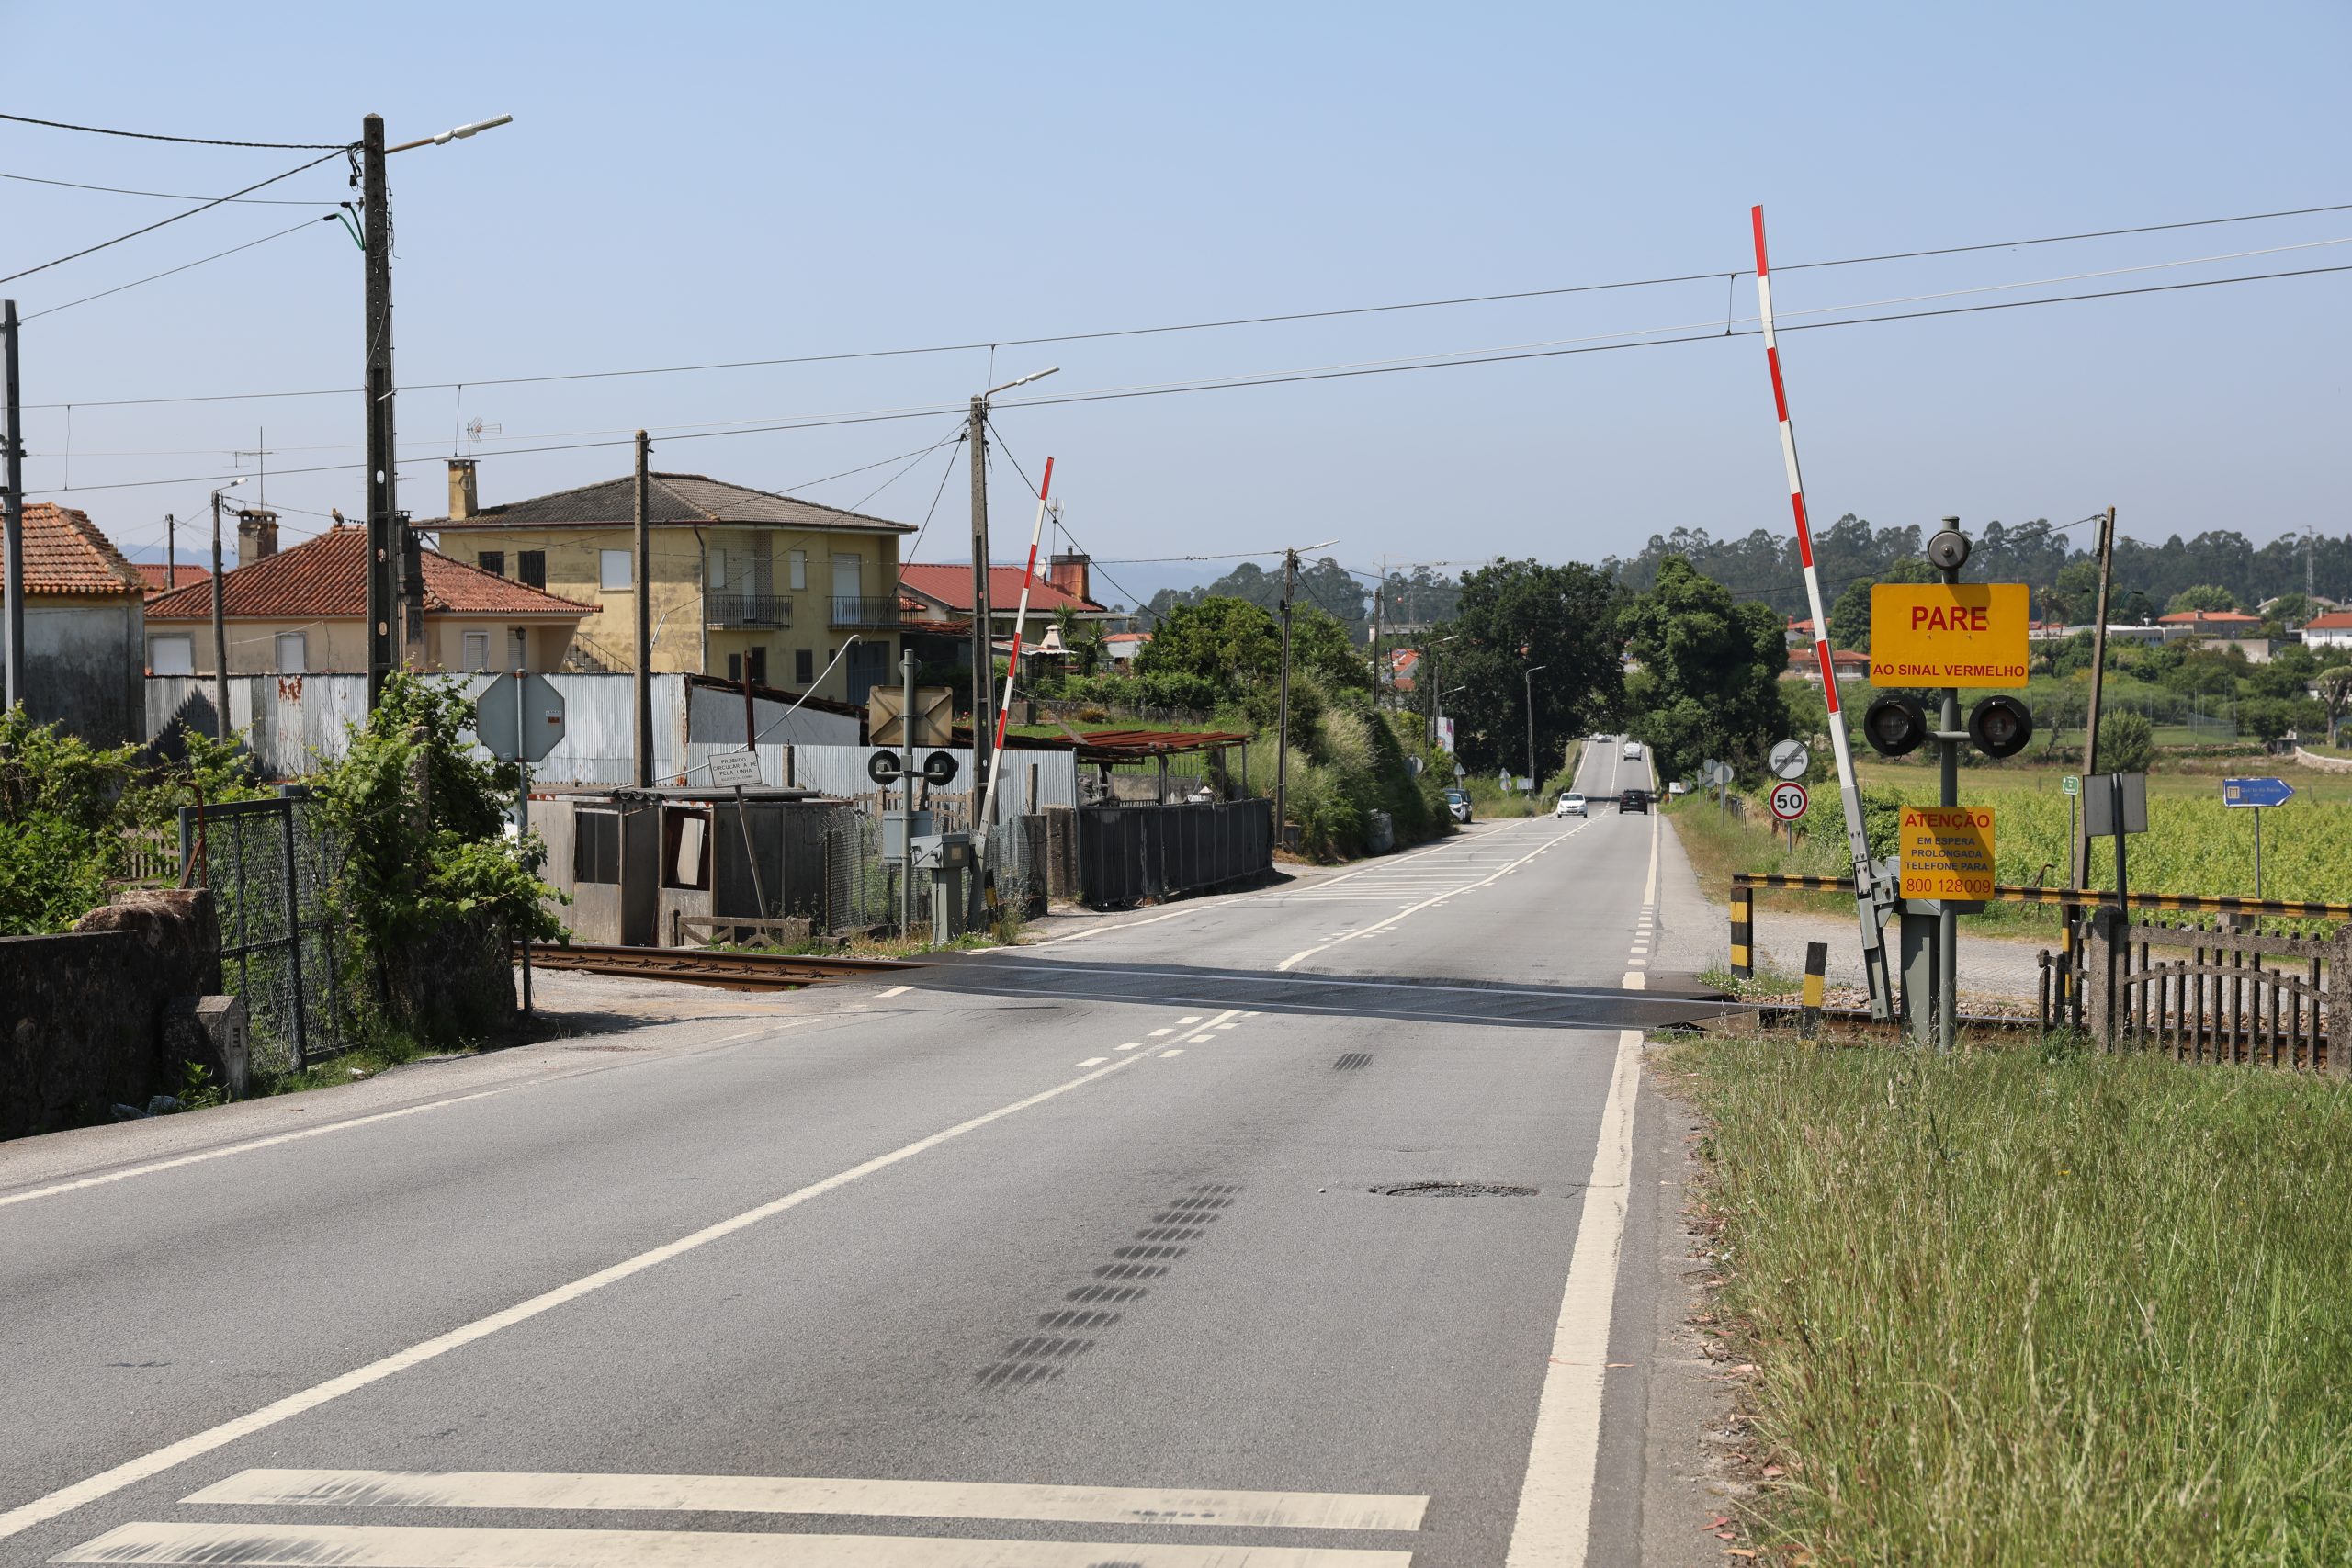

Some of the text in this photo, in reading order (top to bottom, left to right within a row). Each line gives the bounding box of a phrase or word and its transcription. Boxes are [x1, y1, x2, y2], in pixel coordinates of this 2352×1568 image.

[1911, 606, 1987, 631] PARE
[1873, 664, 2025, 677] AO SINAL VERMELHO
[1777, 794, 1802, 809] 50
[1905, 812, 1990, 830] ATENÇÃO
[1911, 849, 1982, 858] PROLONGADA
[1961, 863, 1988, 871] PARA
[1906, 879, 1932, 892] 800
